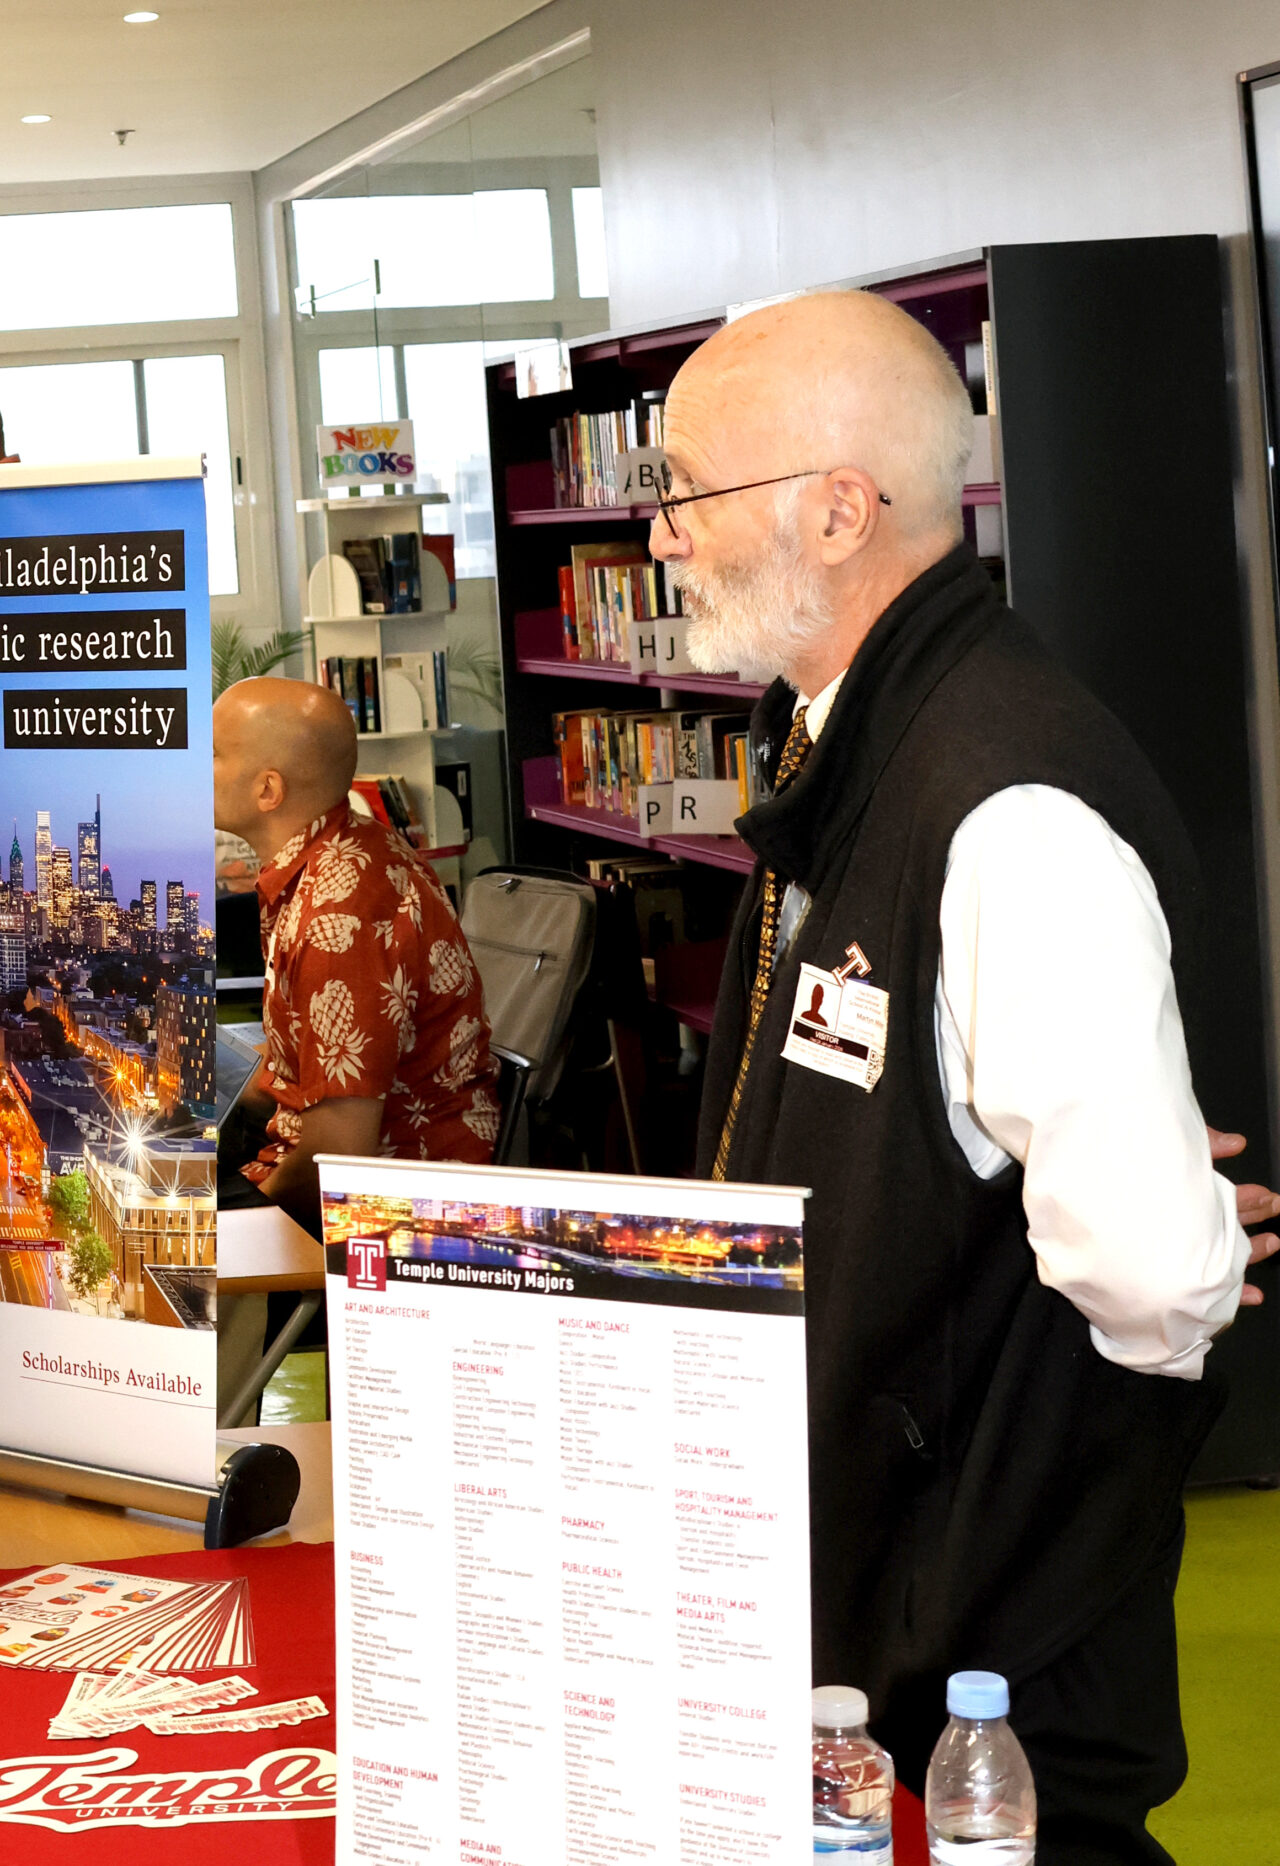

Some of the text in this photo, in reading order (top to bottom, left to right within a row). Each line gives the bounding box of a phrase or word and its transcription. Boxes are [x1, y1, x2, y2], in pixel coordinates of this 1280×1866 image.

[331, 426, 401, 452] NEW
[321, 452, 415, 478] BOOKS
[639, 464, 654, 488] B
[38, 619, 174, 660] research
[639, 634, 656, 658] H
[666, 634, 676, 662] J
[13, 698, 176, 746] university
[647, 802, 660, 824] P
[681, 796, 697, 820] R
[815, 1031, 840, 1044] VISITOR
[395, 1259, 574, 1293] Temple University Majors
[345, 1302, 431, 1320] ART AND ARCHITECTURE
[559, 1318, 630, 1333] MUSIC AND DANCE
[22, 1350, 202, 1397] Scholarships Available
[452, 1362, 504, 1376] ENGINEERING
[674, 1442, 730, 1458] SOCIAL WORK
[454, 1483, 507, 1499] LIBERAL ARTS
[675, 1488, 752, 1506] SPORT, TOURISM AND
[675, 1502, 778, 1522] HOSPITALITY MANAGEMENT
[562, 1516, 605, 1530] PHARMACY
[350, 1550, 384, 1566] BUSINESS
[562, 1562, 622, 1579] PUBLIC HEALTH
[677, 1591, 757, 1612] THEATER, FILM AND
[677, 1608, 725, 1623] MEDIA ARTS
[564, 1690, 615, 1707] SCIENCE AND
[564, 1704, 616, 1722] TECHNOLOGY
[678, 1697, 727, 1713] UNIVERSITY
[729, 1706, 767, 1720] COLLEGE
[353, 1756, 438, 1781] EDUCATION AND HUMAN
[353, 1770, 403, 1789] DEVELOPMENT
[679, 1784, 766, 1807] UNIVERSITY STUDIES
[76, 1802, 294, 1818] UNIVERSITY
[460, 1838, 502, 1855] MEDIA AND
